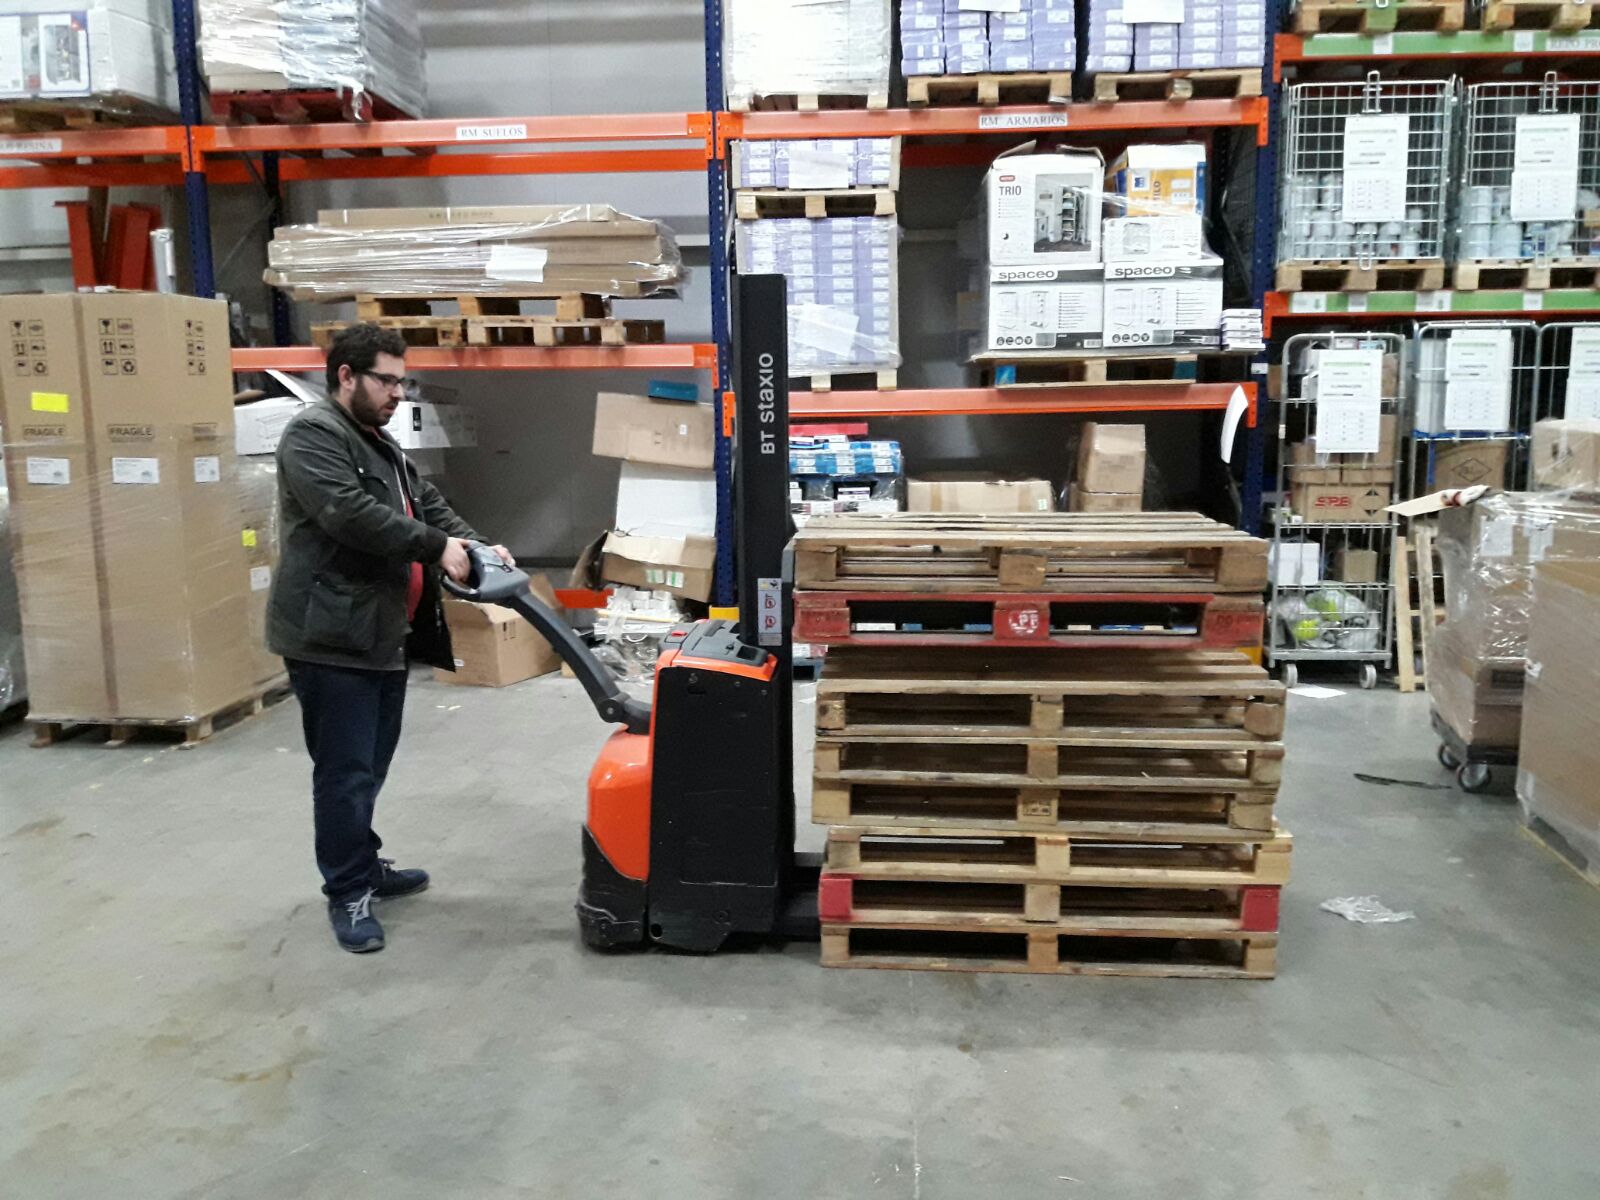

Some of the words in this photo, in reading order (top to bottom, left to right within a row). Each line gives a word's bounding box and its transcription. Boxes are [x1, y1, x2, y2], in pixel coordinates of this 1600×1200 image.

[982, 116, 998, 127] RM
[1007, 113, 1067, 126] ARMARIOS
[461, 128, 478, 138] RM
[482, 127, 524, 137] SUELOS
[998, 185, 1022, 196] TRIO
[998, 269, 1055, 282] spaceo
[1114, 265, 1172, 279] spaceo
[23, 426, 65, 437] FRAGILE
[109, 425, 153, 437] FRAGILE
[760, 430, 776, 454] BT
